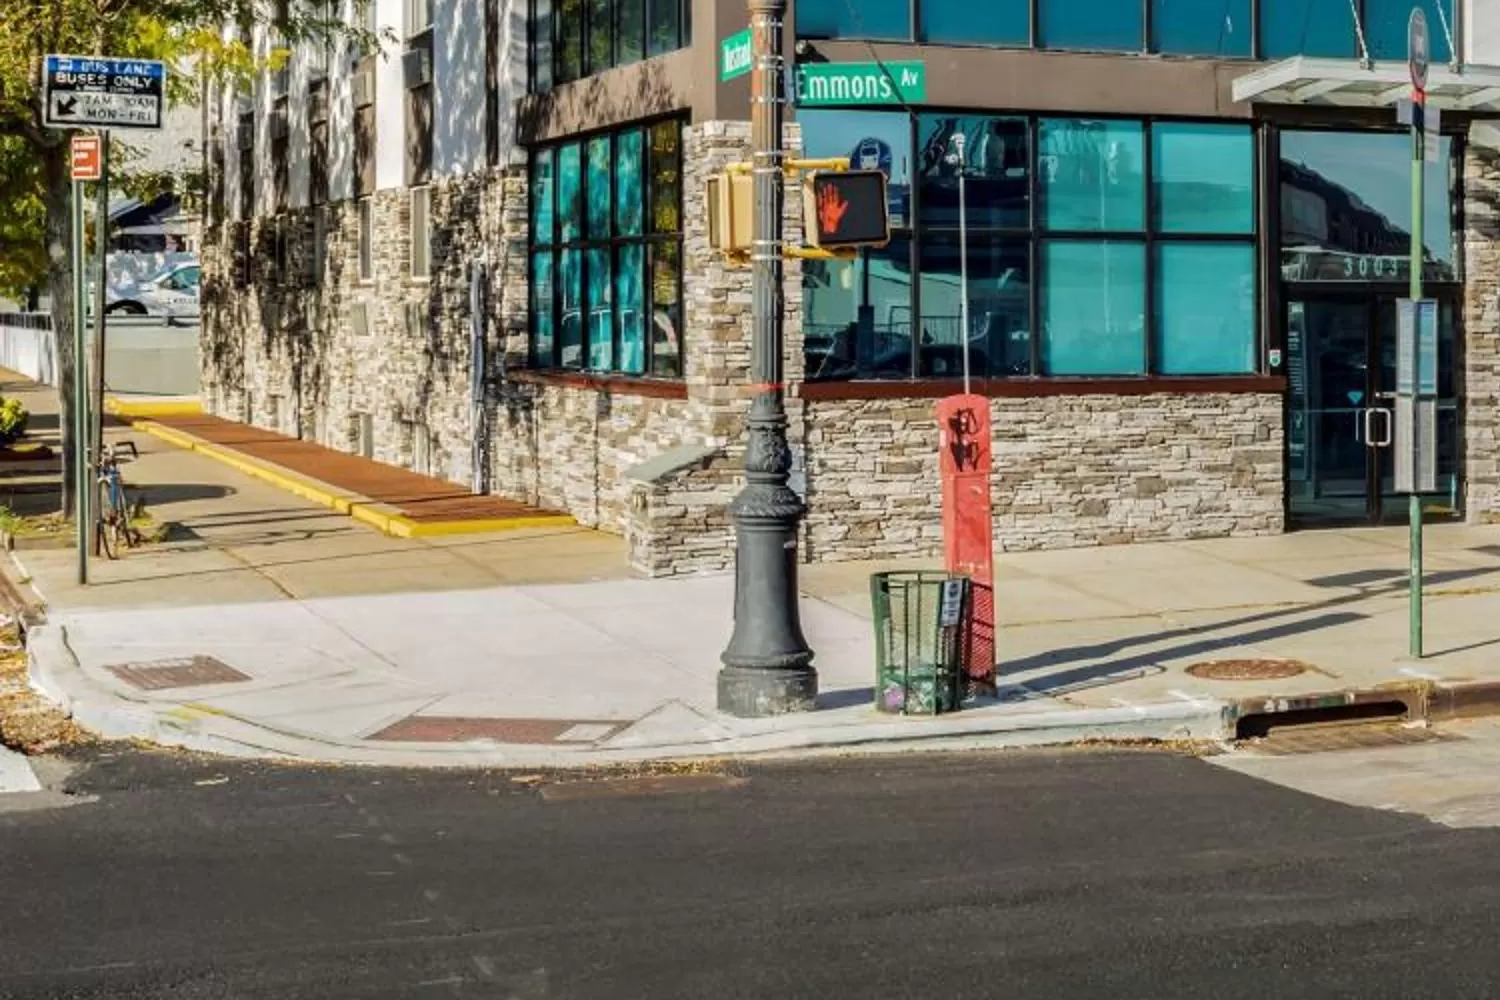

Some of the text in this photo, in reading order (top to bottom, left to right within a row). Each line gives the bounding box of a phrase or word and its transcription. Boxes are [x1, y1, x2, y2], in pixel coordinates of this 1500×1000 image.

[81, 60, 153, 75] BUS LANE
[55, 71, 153, 88] BUSES ONLY
[796, 67, 919, 99] Emmons Av
